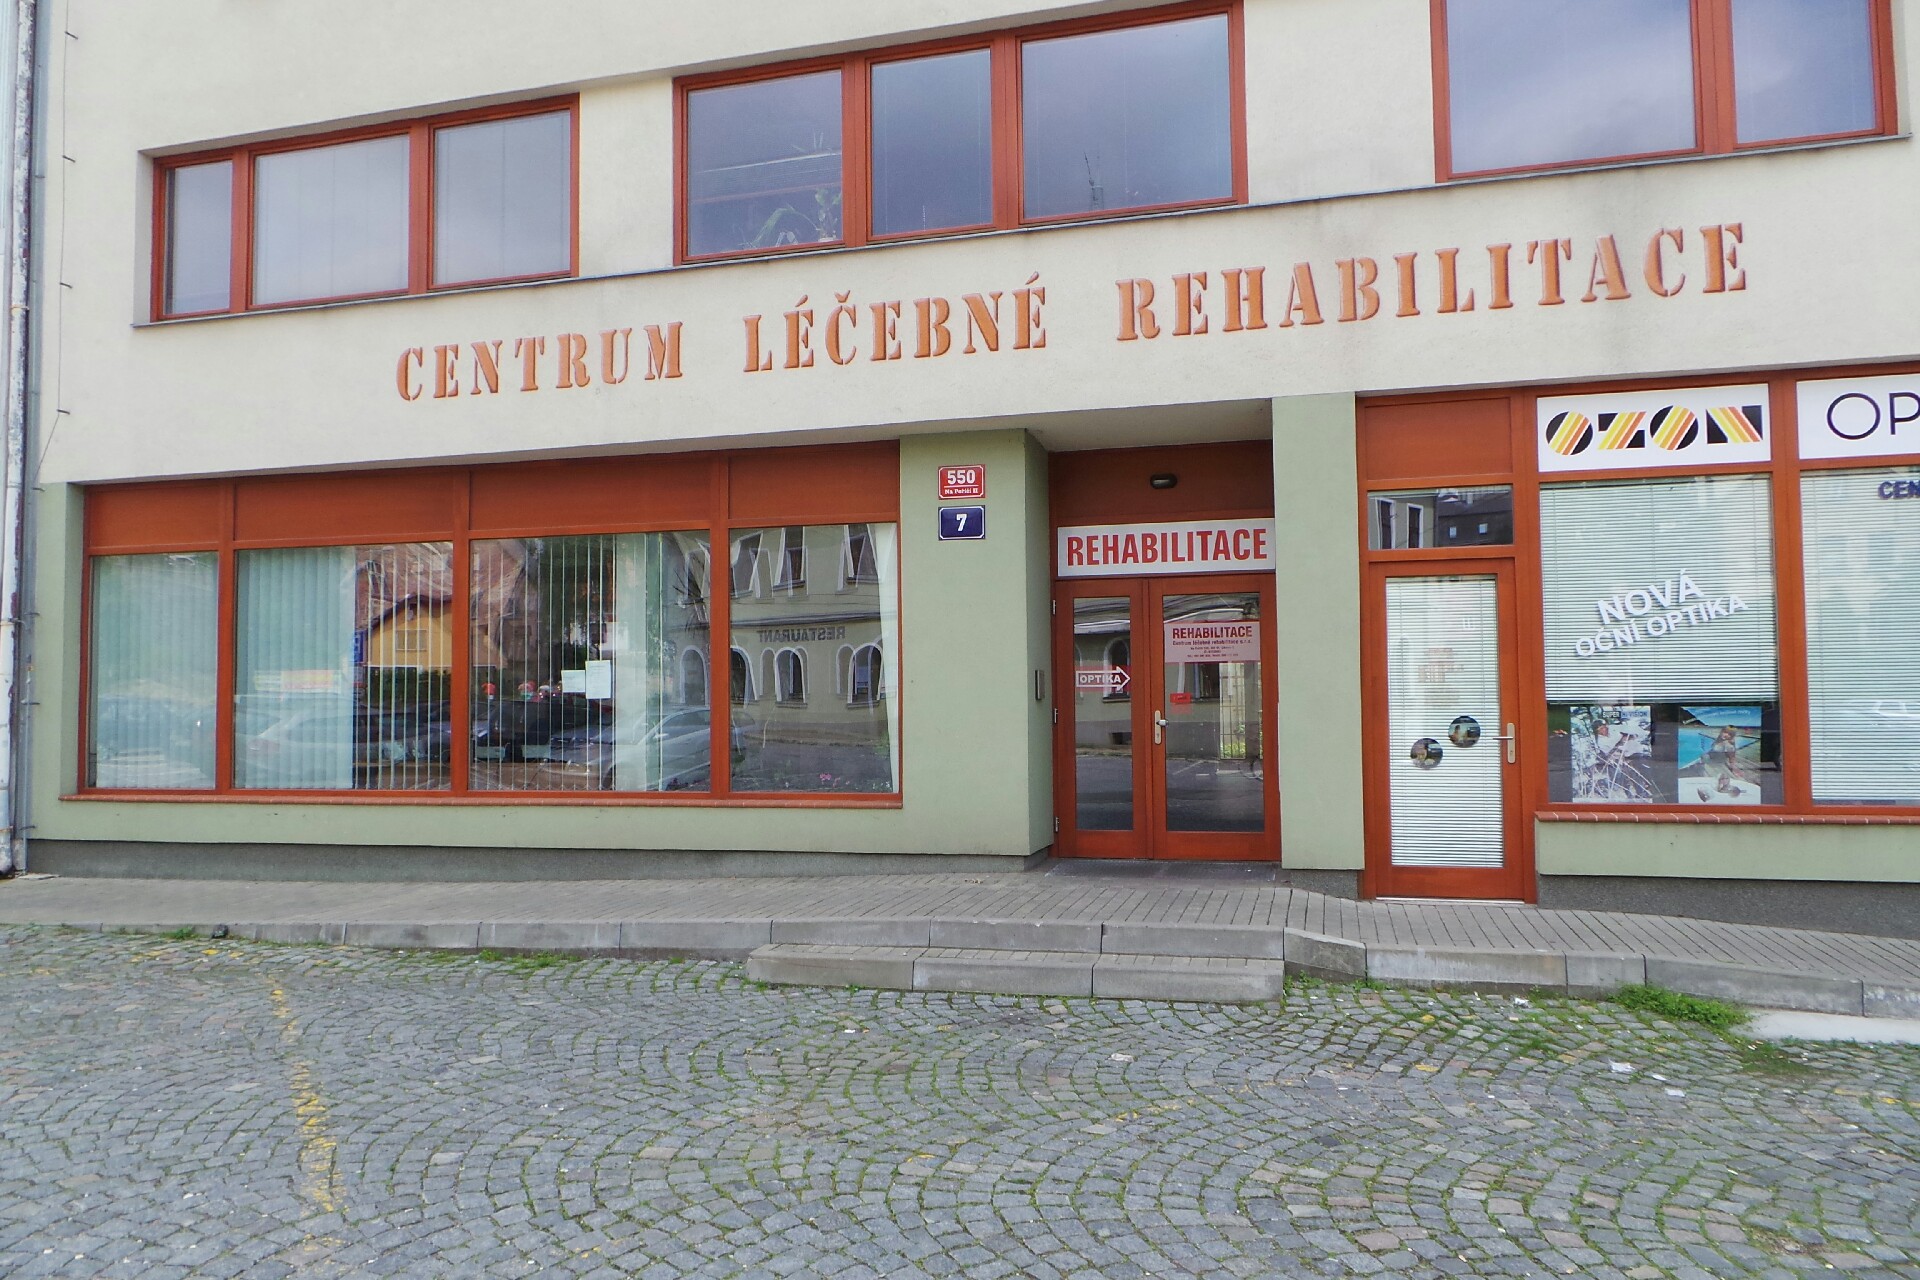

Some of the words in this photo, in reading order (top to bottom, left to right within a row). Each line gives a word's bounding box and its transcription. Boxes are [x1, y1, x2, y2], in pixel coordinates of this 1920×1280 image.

[396, 321, 683, 401] CENTRUM
[742, 271, 1046, 372] LÉČEBNÉ
[1115, 222, 1747, 341] REHABILITACE
[1545, 405, 1763, 456] OZON
[947, 469, 976, 485] 550
[956, 513, 967, 532] 7
[1067, 528, 1267, 566] REHABILITACE
[1597, 568, 1704, 625] NOVÁ
[1647, 594, 1748, 636] OPTIKA
[1172, 626, 1252, 639] REHABILITACE
[1080, 675, 1121, 683] OPTIKA
